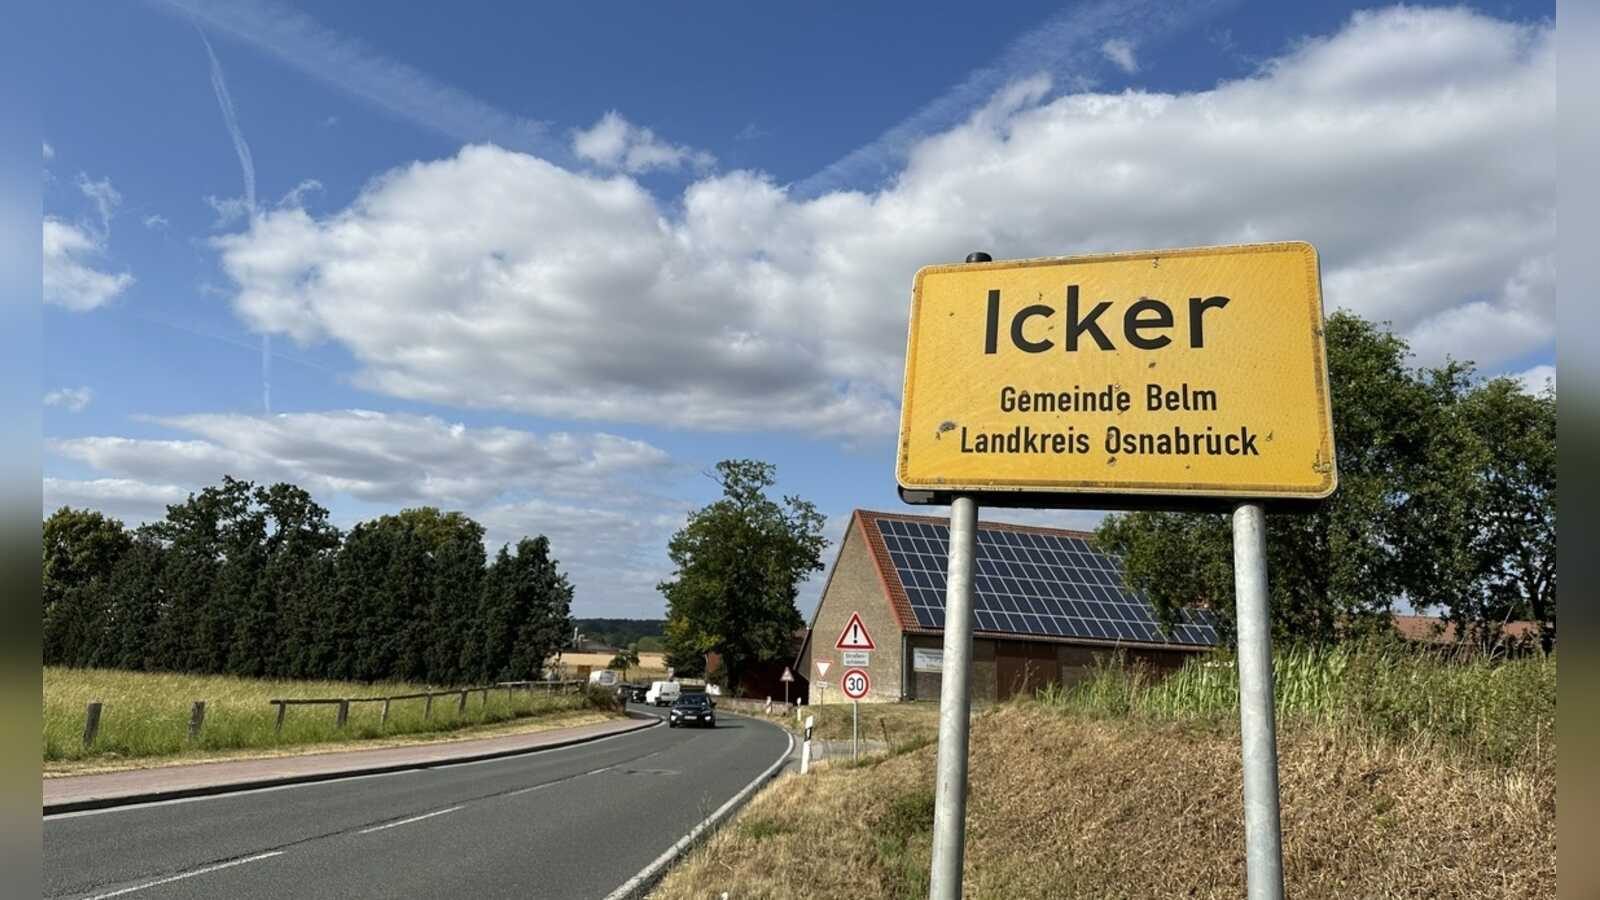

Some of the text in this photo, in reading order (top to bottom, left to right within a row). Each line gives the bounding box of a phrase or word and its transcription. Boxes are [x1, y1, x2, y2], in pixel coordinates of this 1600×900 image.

[984, 284, 1231, 355] Icker
[1000, 383, 1217, 413] Gemeinde Belm
[961, 426, 1090, 454] Landkreis
[848, 677, 864, 691] 30
